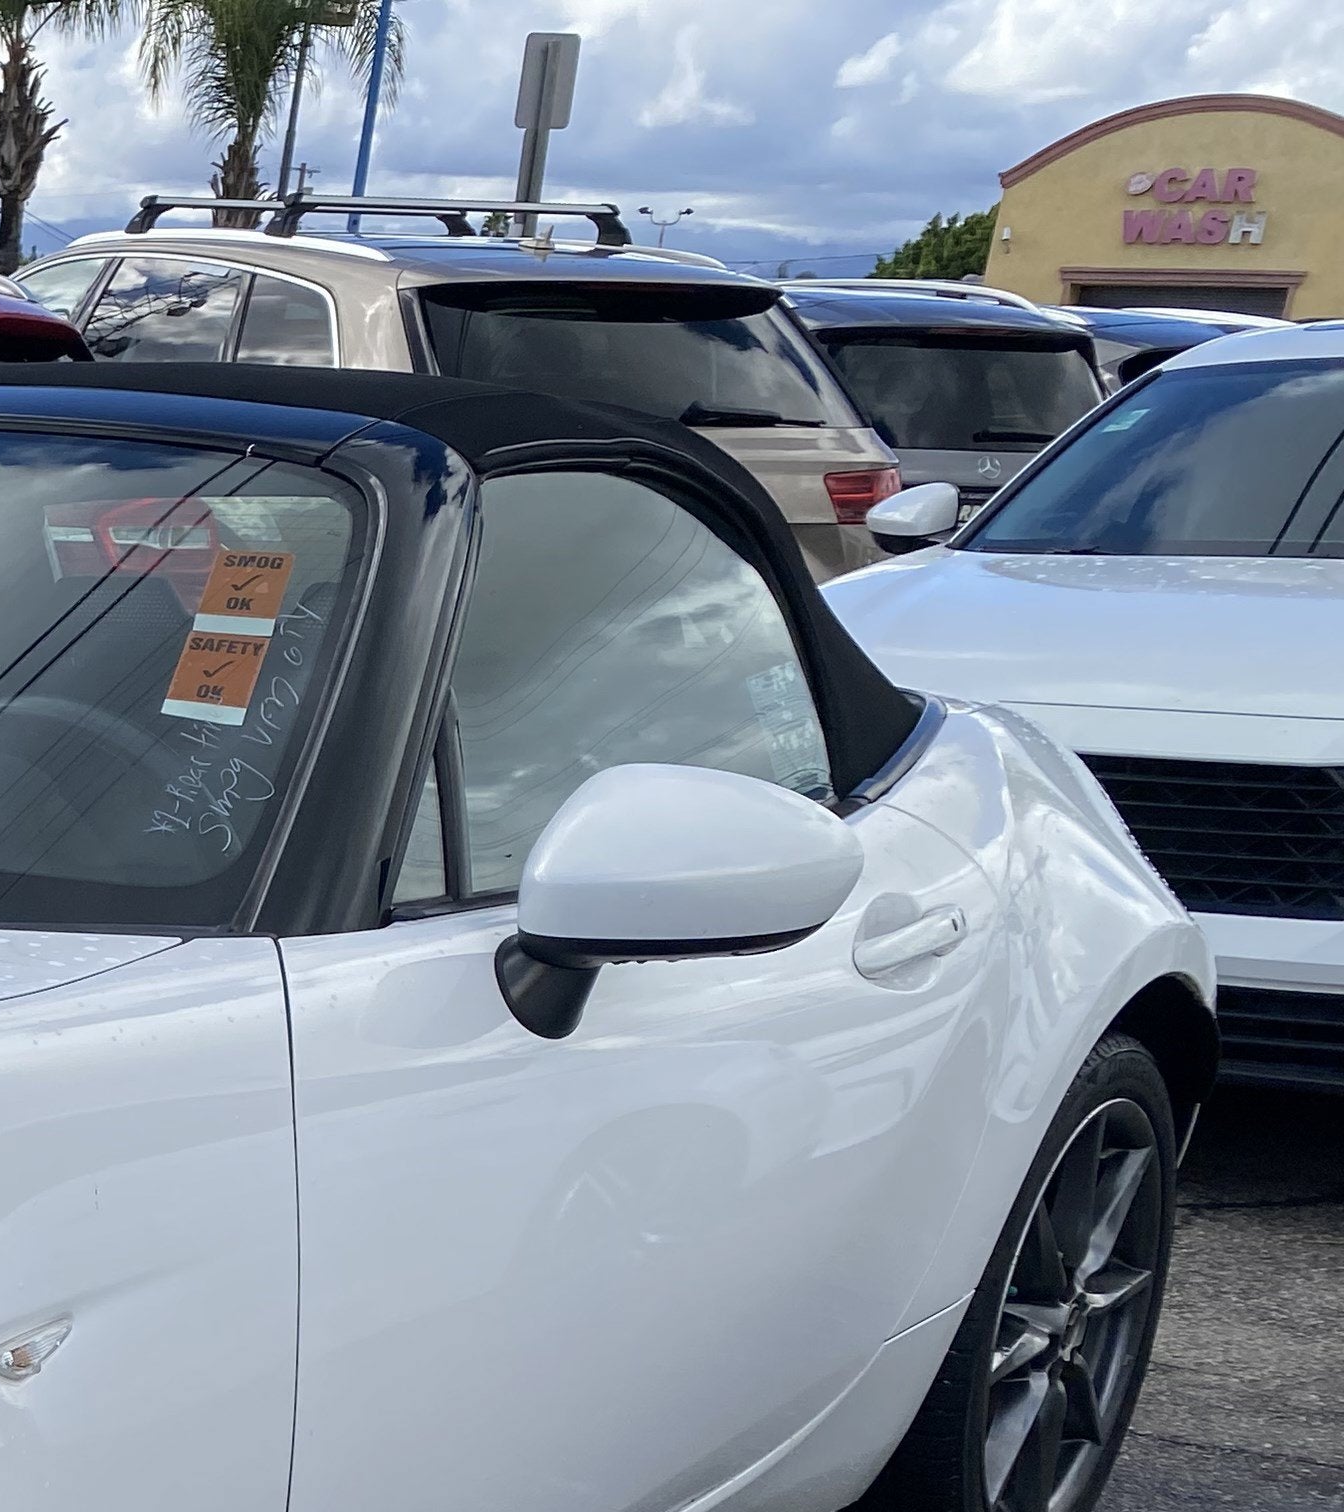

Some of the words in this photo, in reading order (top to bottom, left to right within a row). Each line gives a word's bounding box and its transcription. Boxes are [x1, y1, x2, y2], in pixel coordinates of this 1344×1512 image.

[1153, 167, 1258, 203] CAR
[1122, 209, 1268, 245] WASH
[223, 554, 284, 570] SMOG
[226, 597, 253, 611] OK
[189, 637, 265, 657] SAFETY
[196, 683, 225, 699] OK
